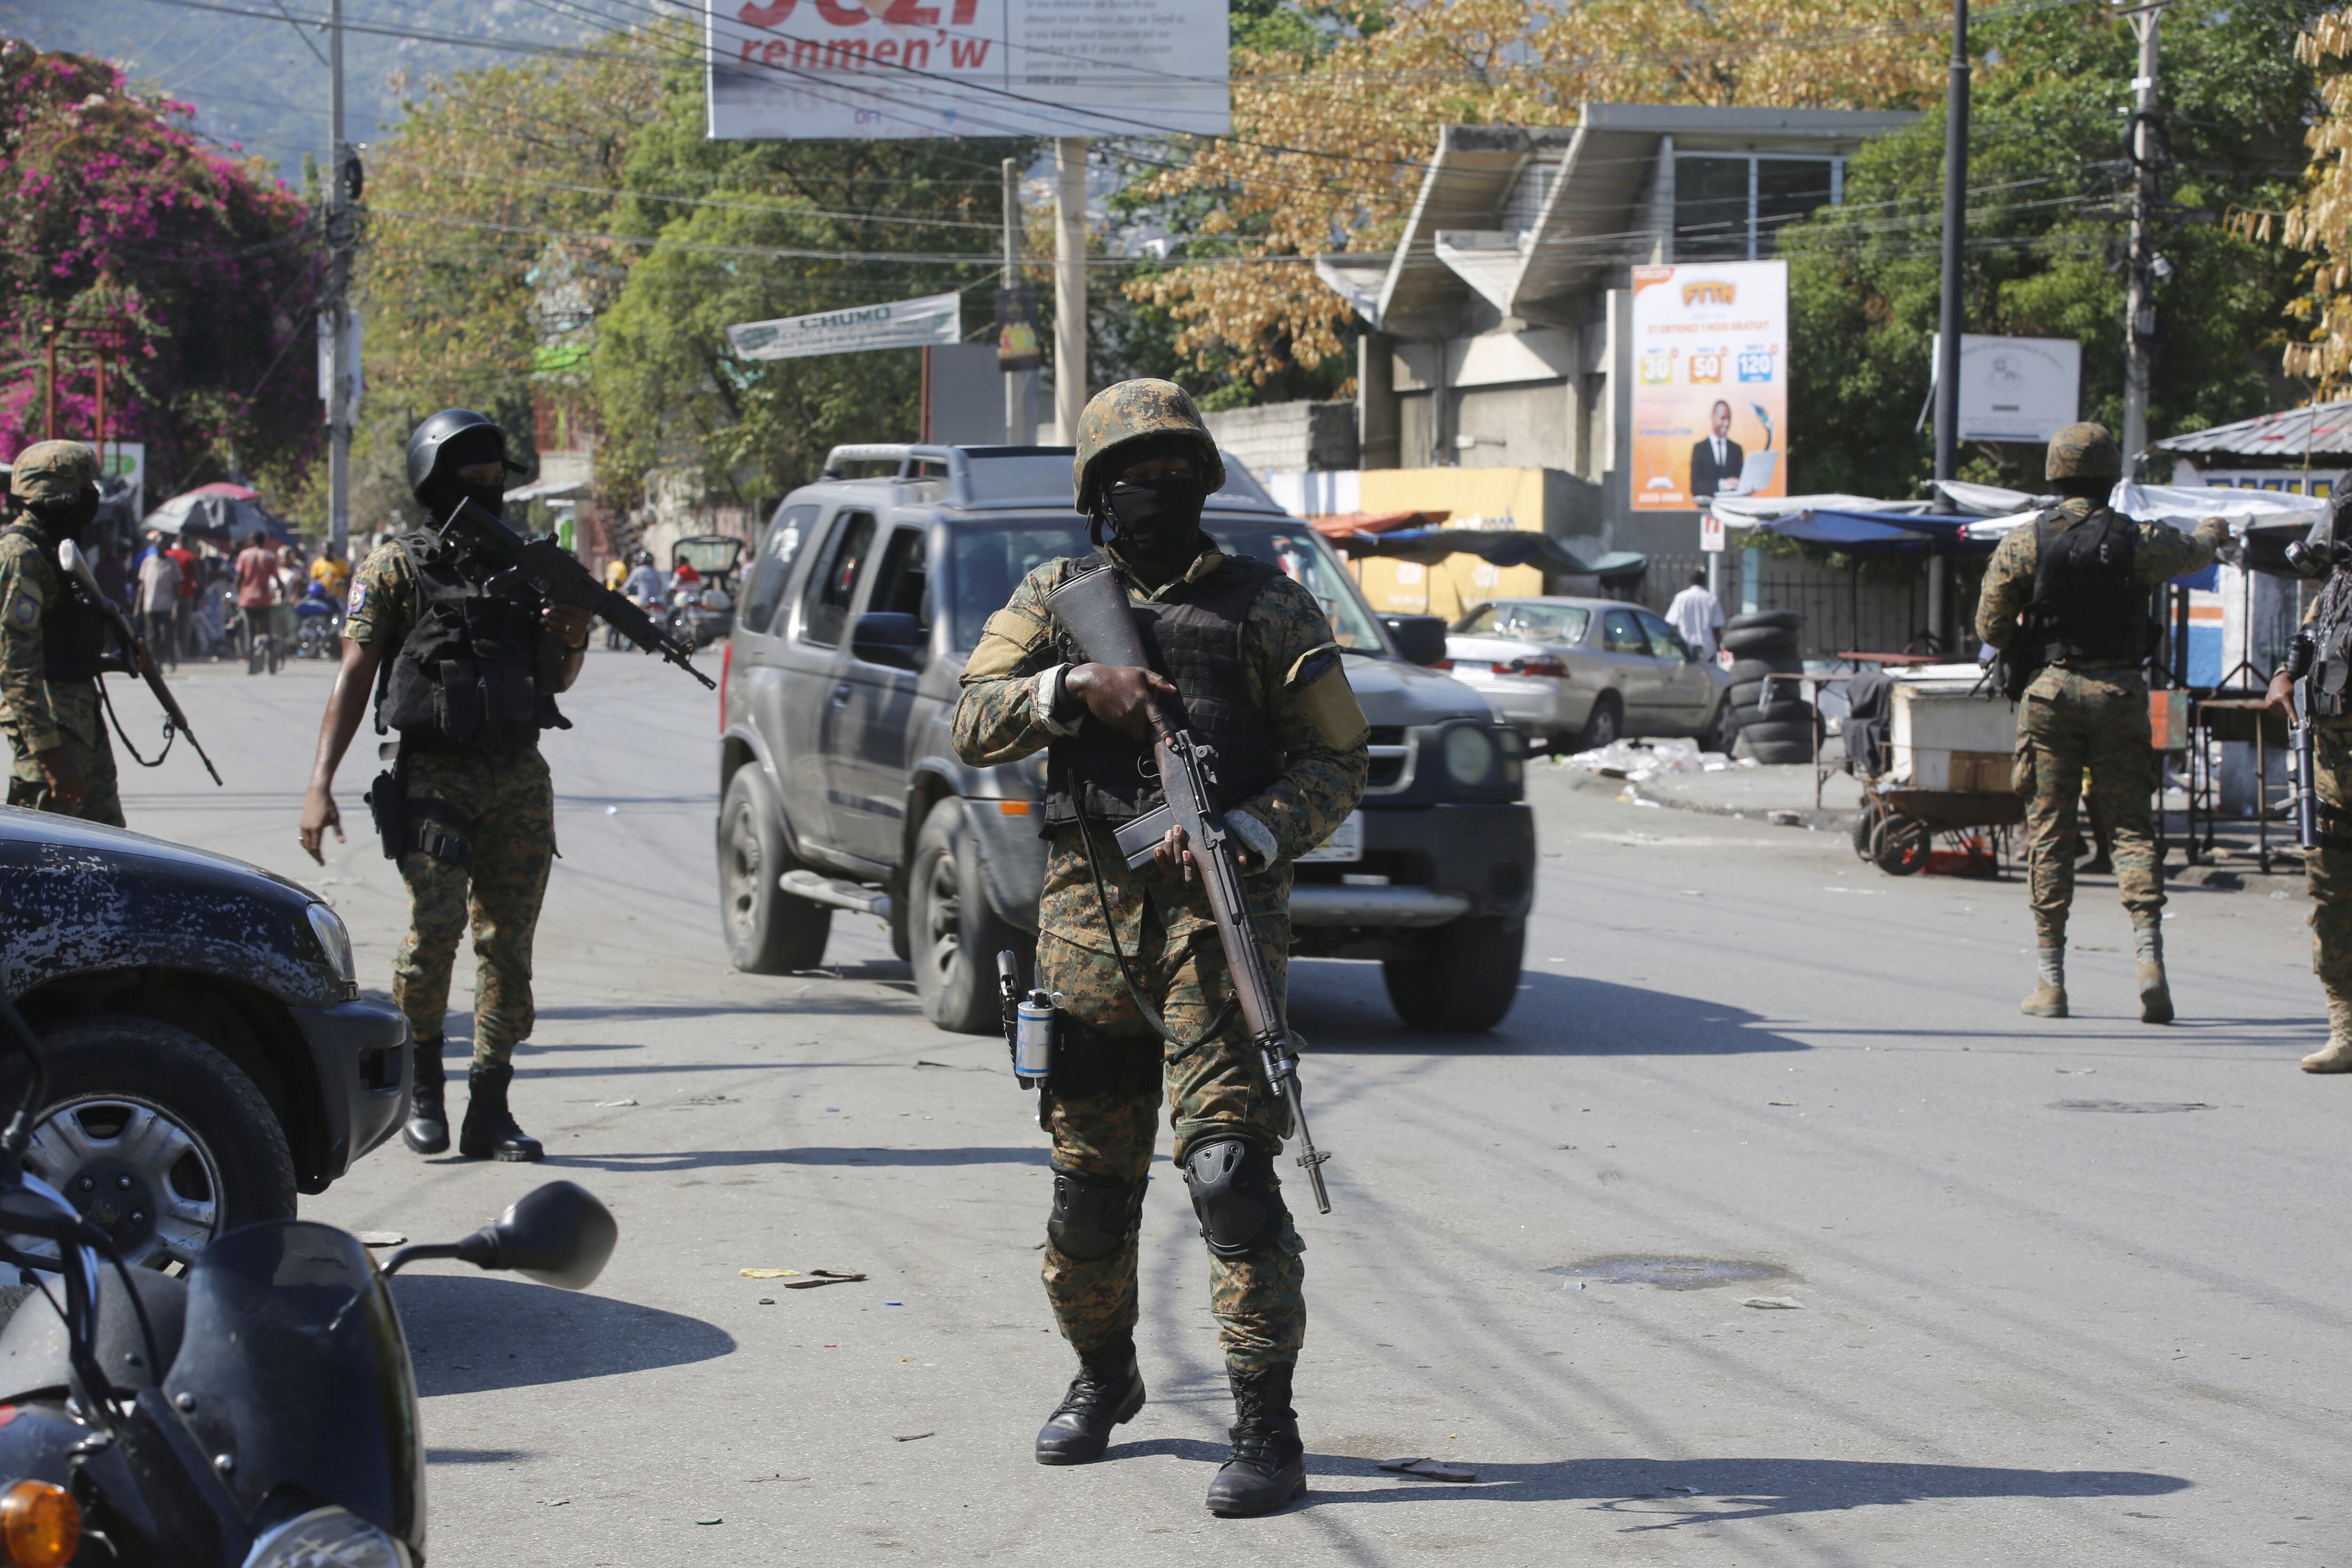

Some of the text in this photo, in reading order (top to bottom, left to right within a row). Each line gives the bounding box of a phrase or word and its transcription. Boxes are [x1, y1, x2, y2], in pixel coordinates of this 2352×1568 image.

[738, 29, 991, 69] renmen'w
[1643, 358, 1670, 381] 30
[1693, 356, 1719, 379] 50
[1739, 355, 1771, 375] 120
